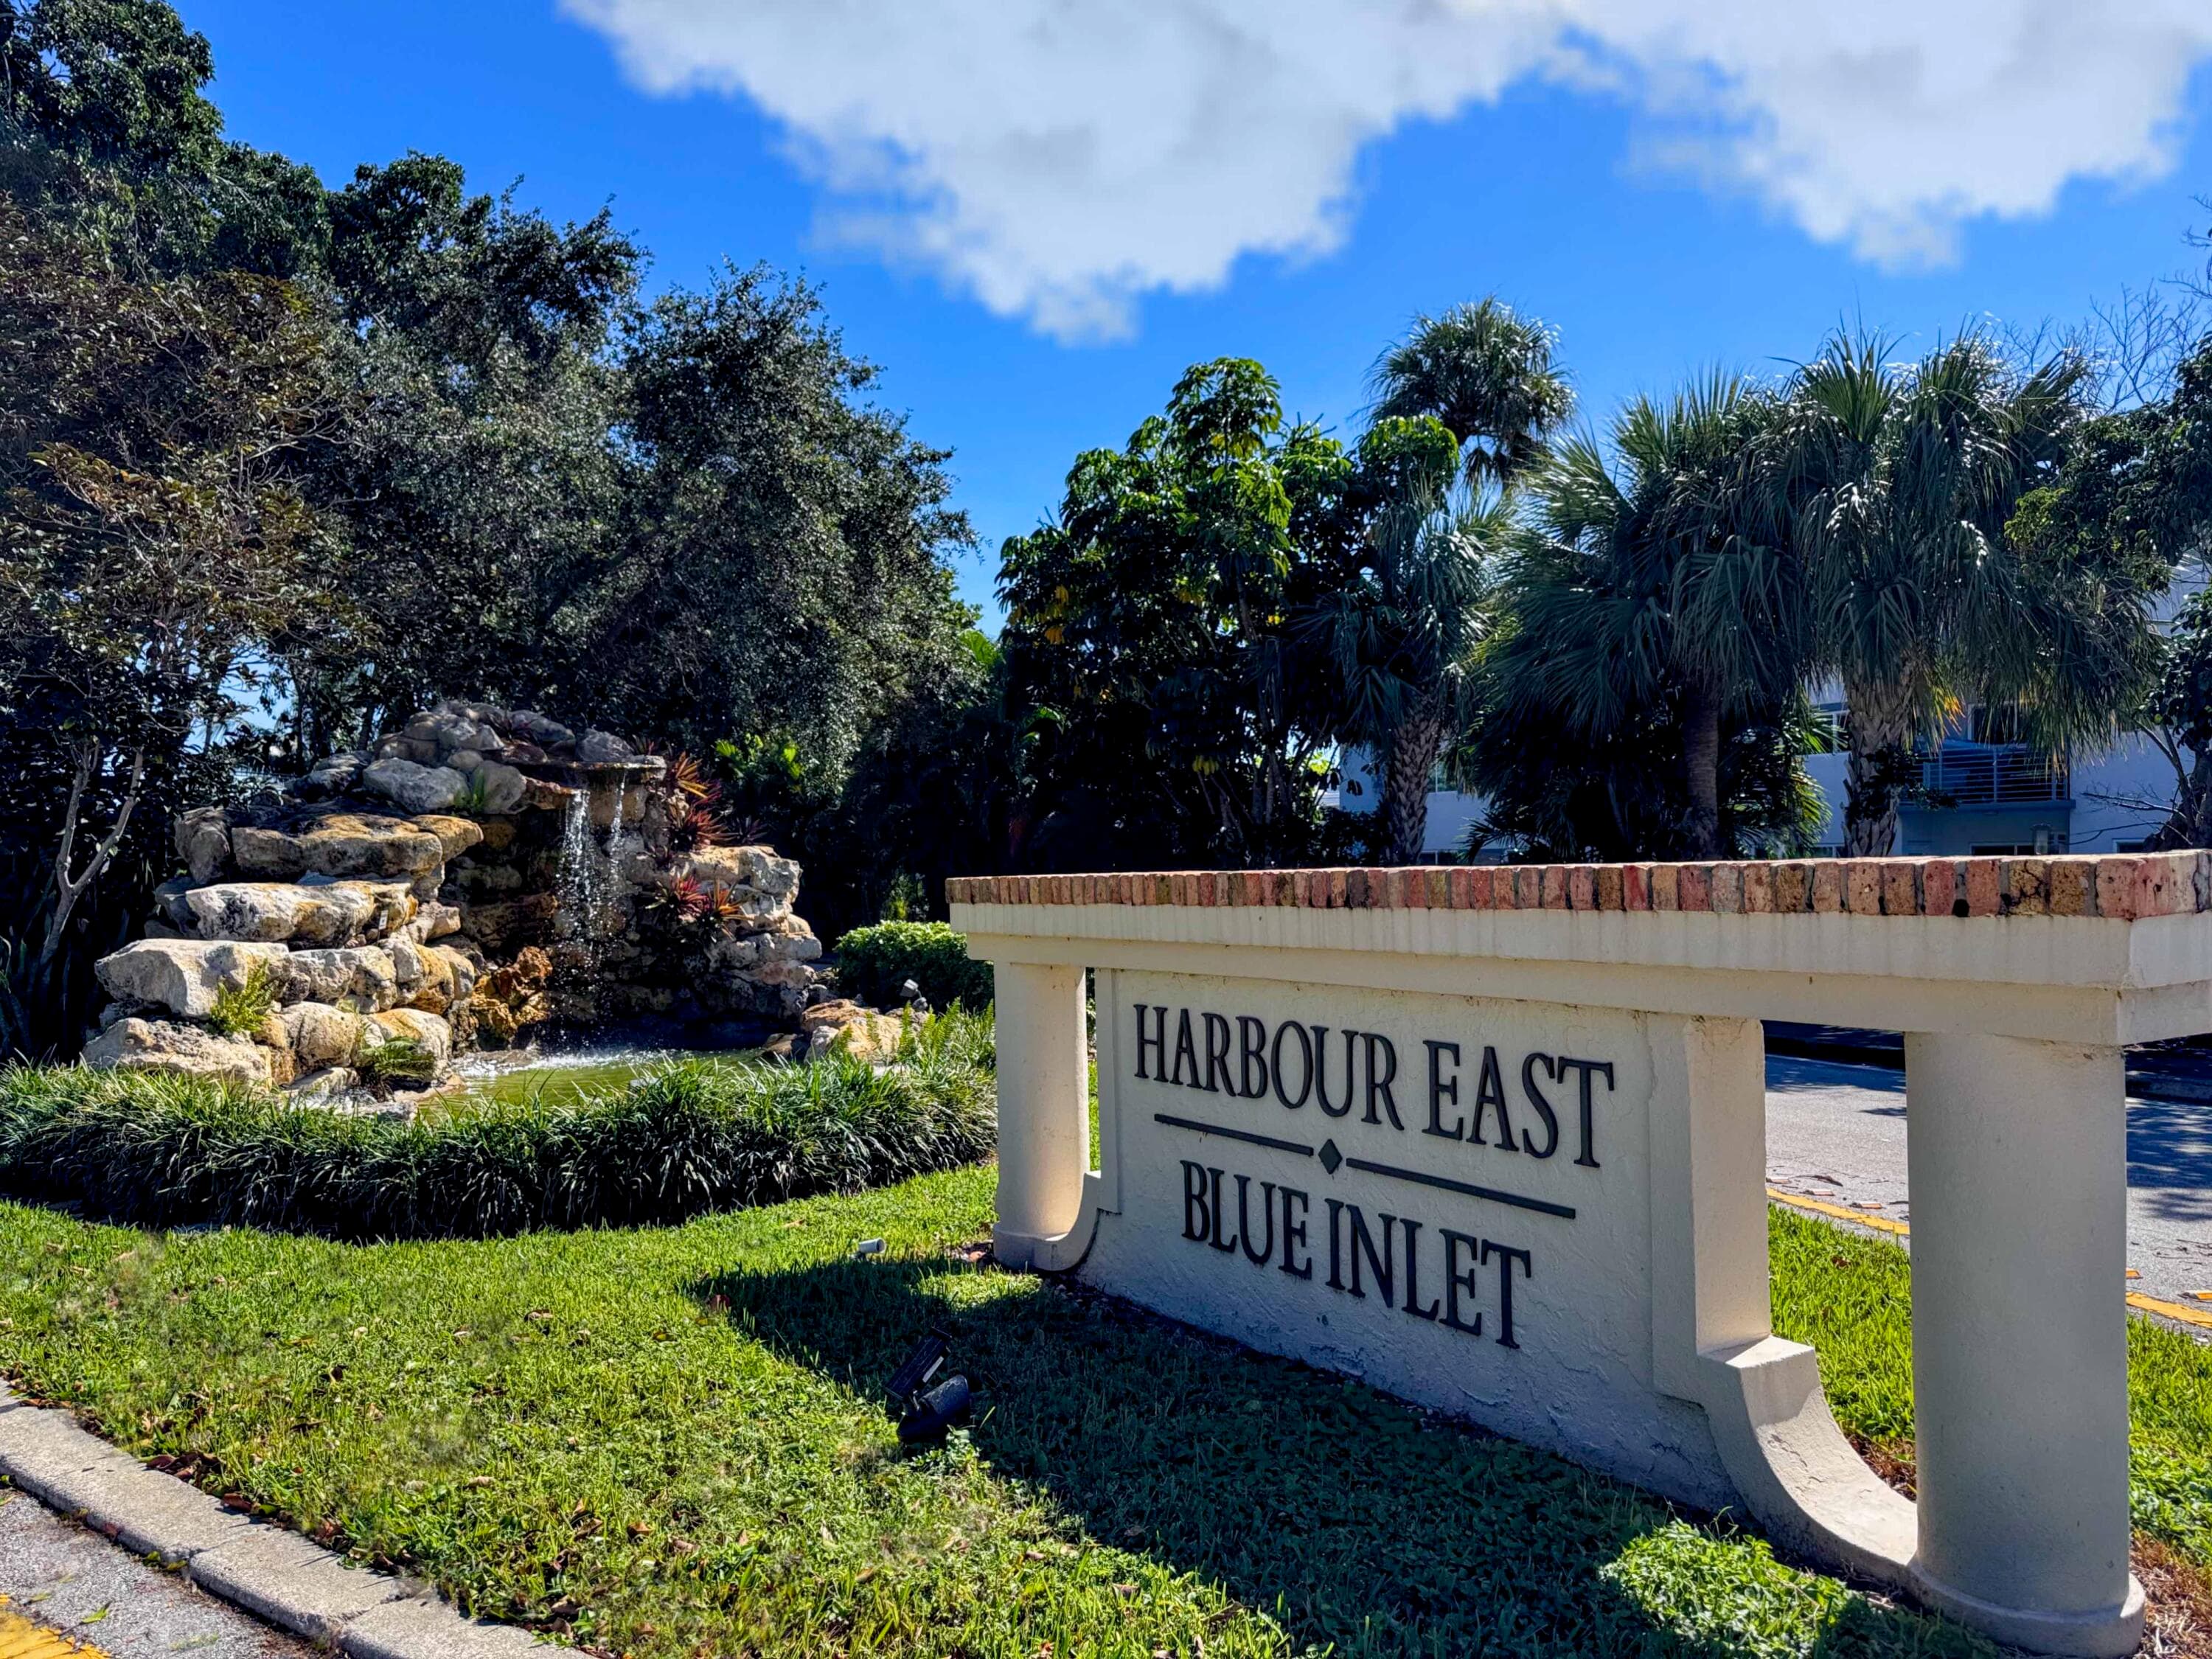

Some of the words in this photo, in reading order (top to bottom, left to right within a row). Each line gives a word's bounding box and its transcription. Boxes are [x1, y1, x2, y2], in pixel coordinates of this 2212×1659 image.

[1133, 1004, 1405, 1131] HARBOUR
[1422, 1040, 1615, 1168] EAST
[1180, 1160, 1312, 1280] BLUE
[1325, 1197, 1531, 1349] INLET
